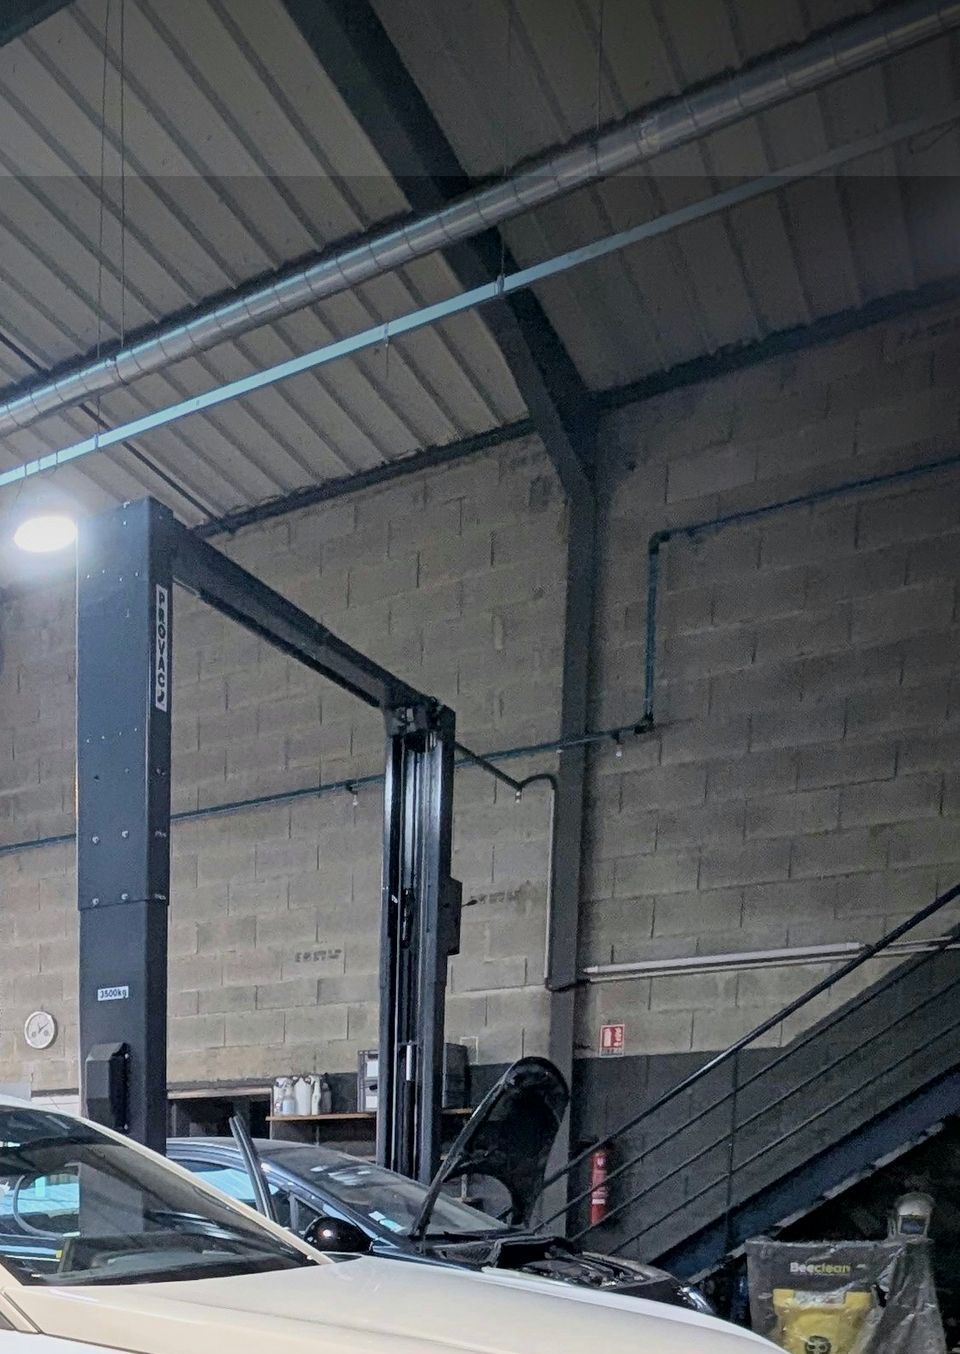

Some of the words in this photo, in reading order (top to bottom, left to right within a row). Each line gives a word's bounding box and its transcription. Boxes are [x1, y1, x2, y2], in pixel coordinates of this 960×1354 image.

[157, 592, 166, 688] PROVAC
[100, 988, 127, 1000] 3500kg
[790, 1262, 850, 1274] Beeclean
